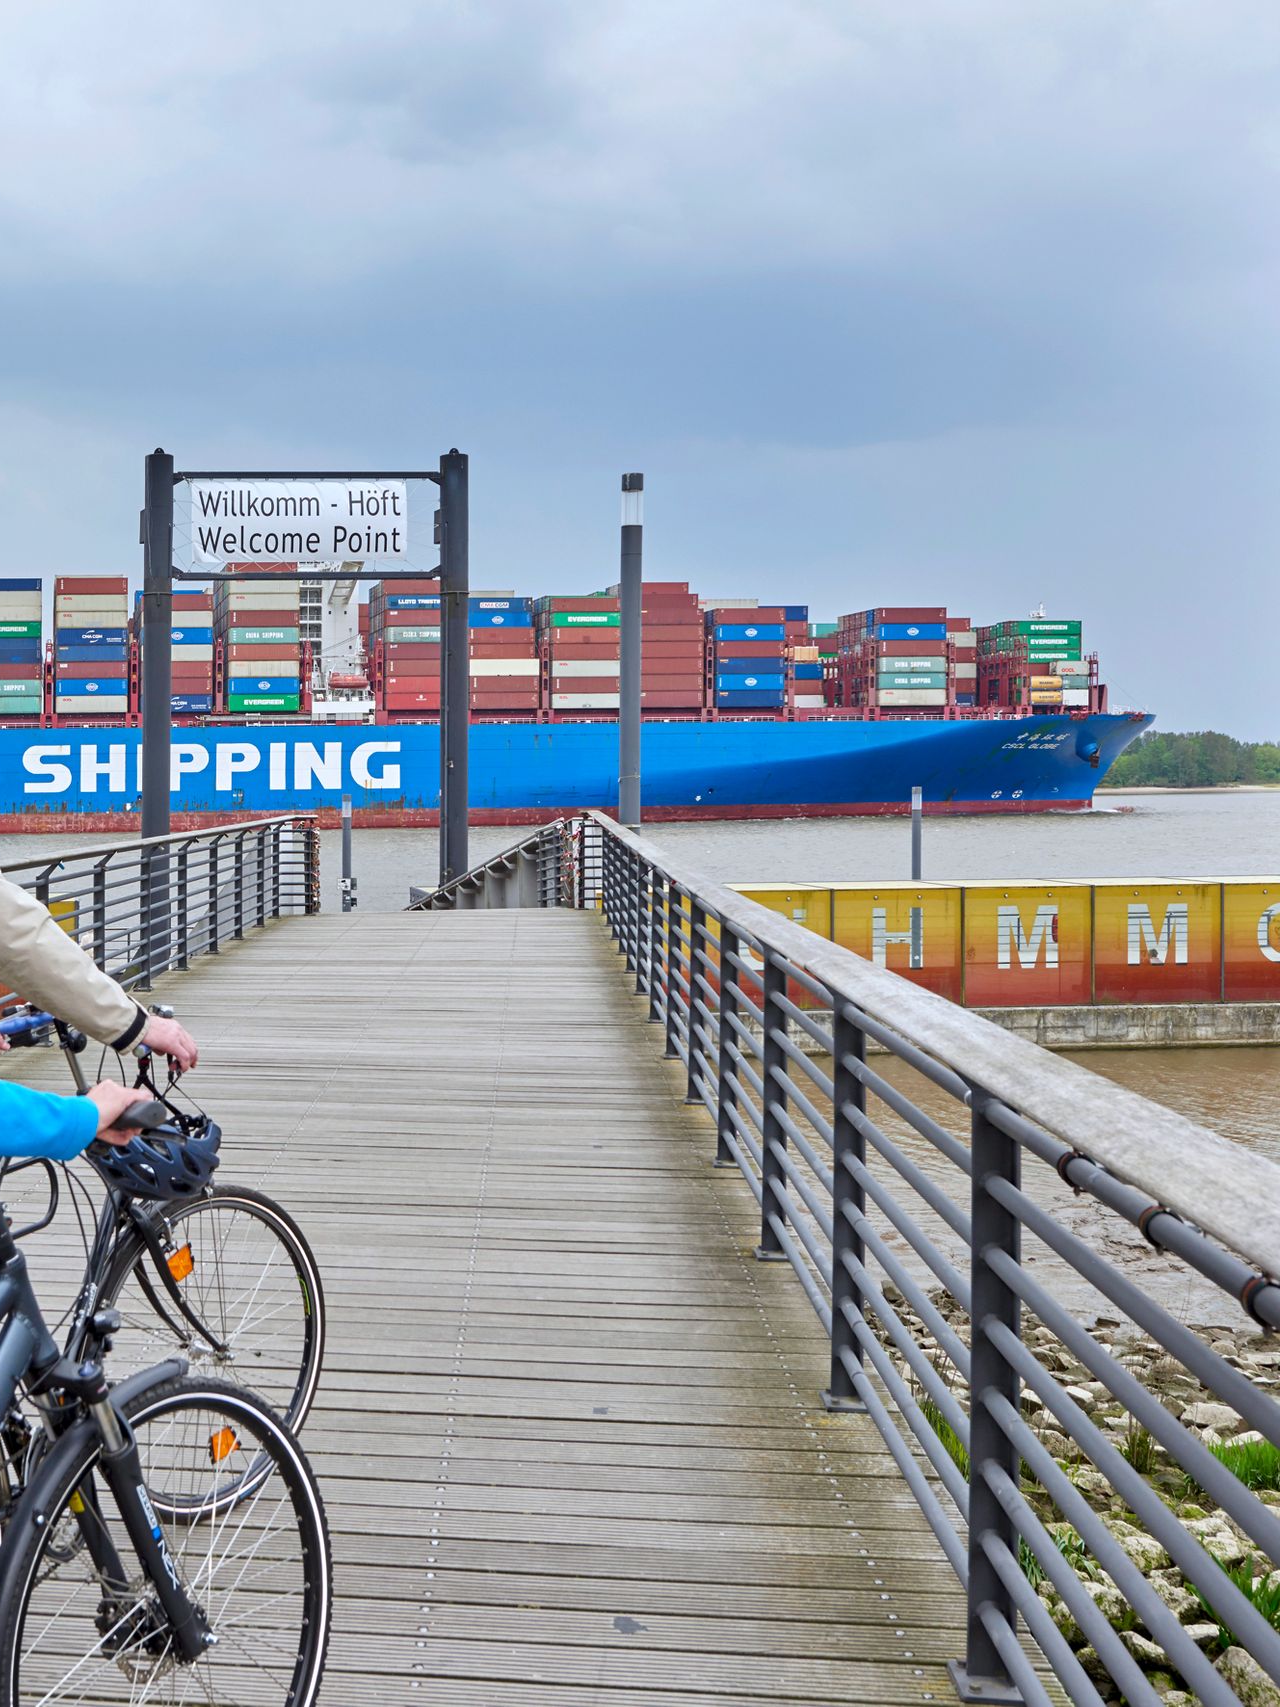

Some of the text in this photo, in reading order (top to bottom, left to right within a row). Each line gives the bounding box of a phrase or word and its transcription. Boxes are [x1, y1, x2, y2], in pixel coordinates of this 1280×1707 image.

[198, 489, 320, 517] Willkomm
[348, 489, 401, 517] Höft
[198, 525, 401, 554] Welcome Point
